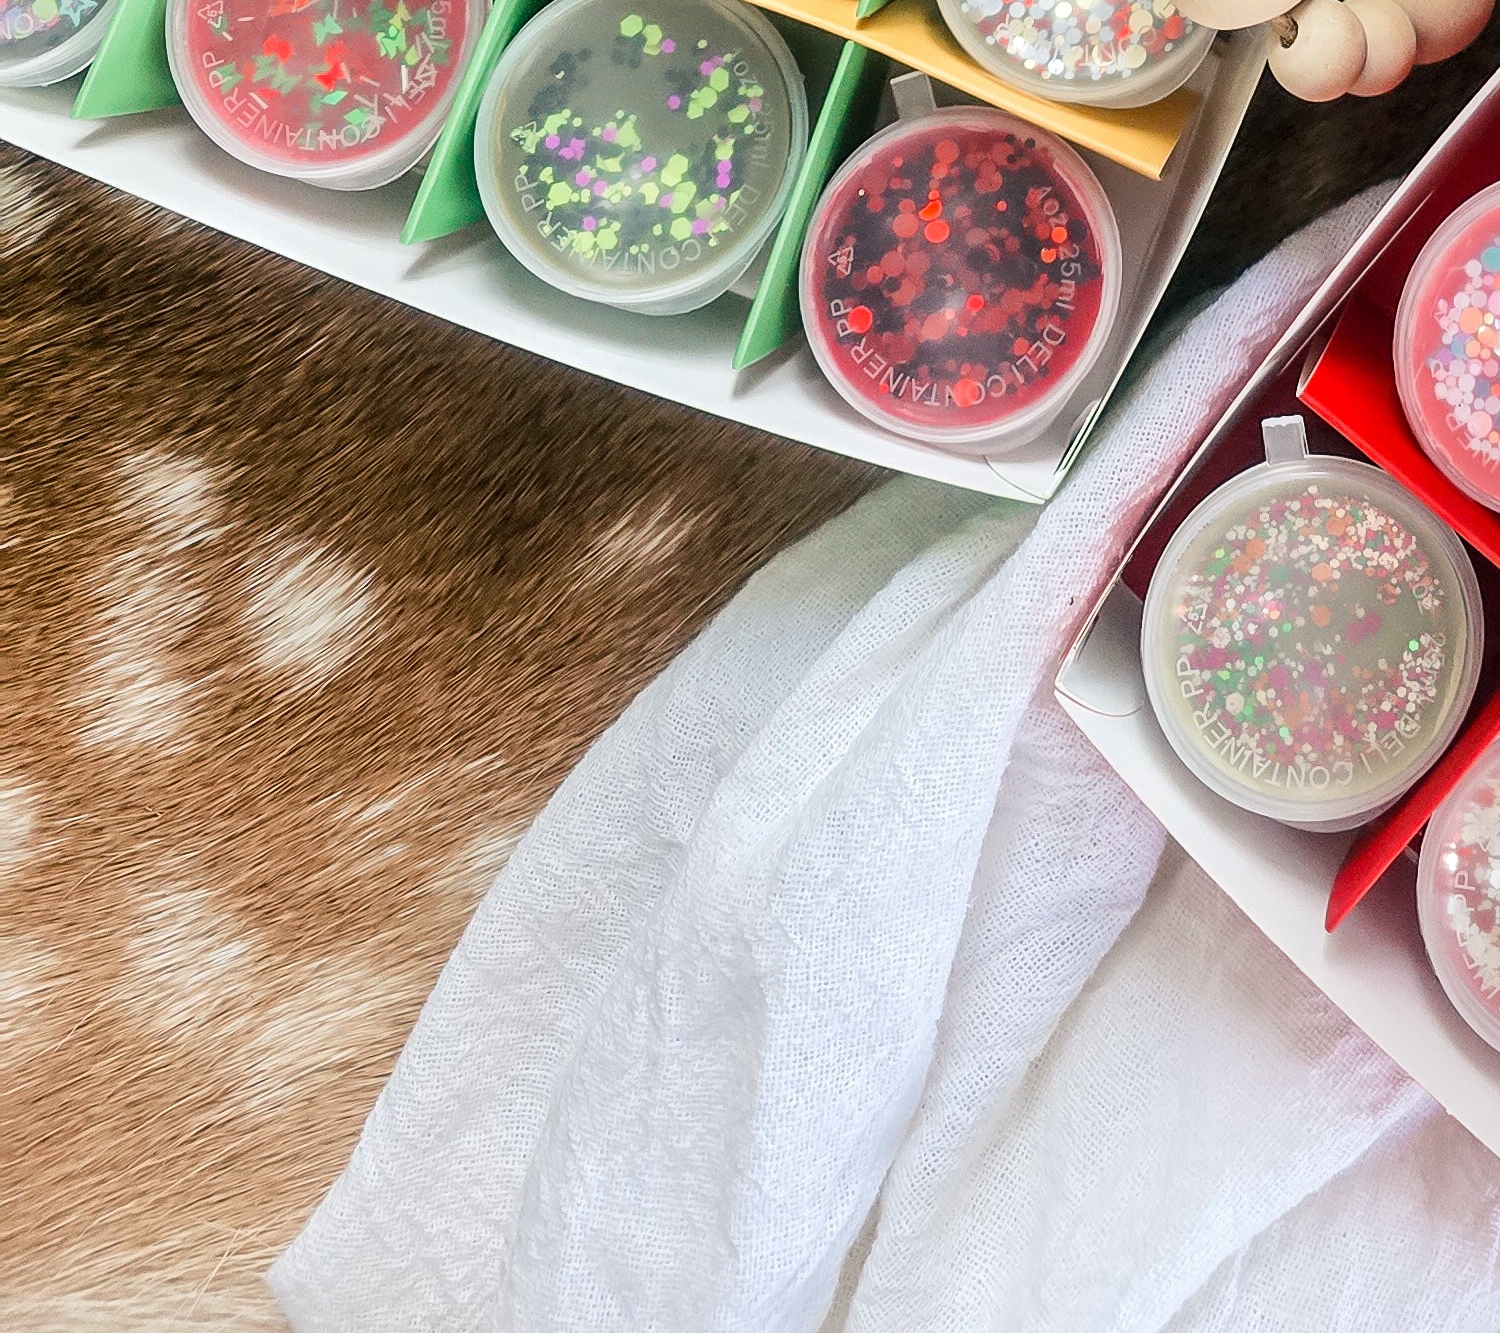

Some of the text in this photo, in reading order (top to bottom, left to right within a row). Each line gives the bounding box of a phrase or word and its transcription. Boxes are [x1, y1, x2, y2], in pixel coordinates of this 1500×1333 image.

[202, 51, 231, 90] PP
[514, 175, 545, 213] PP
[1056, 245, 1085, 312] 25ml
[1010, 322, 1067, 386] DELI
[1176, 658, 1205, 700] PP
[1193, 702, 1354, 790] CONTAINER
